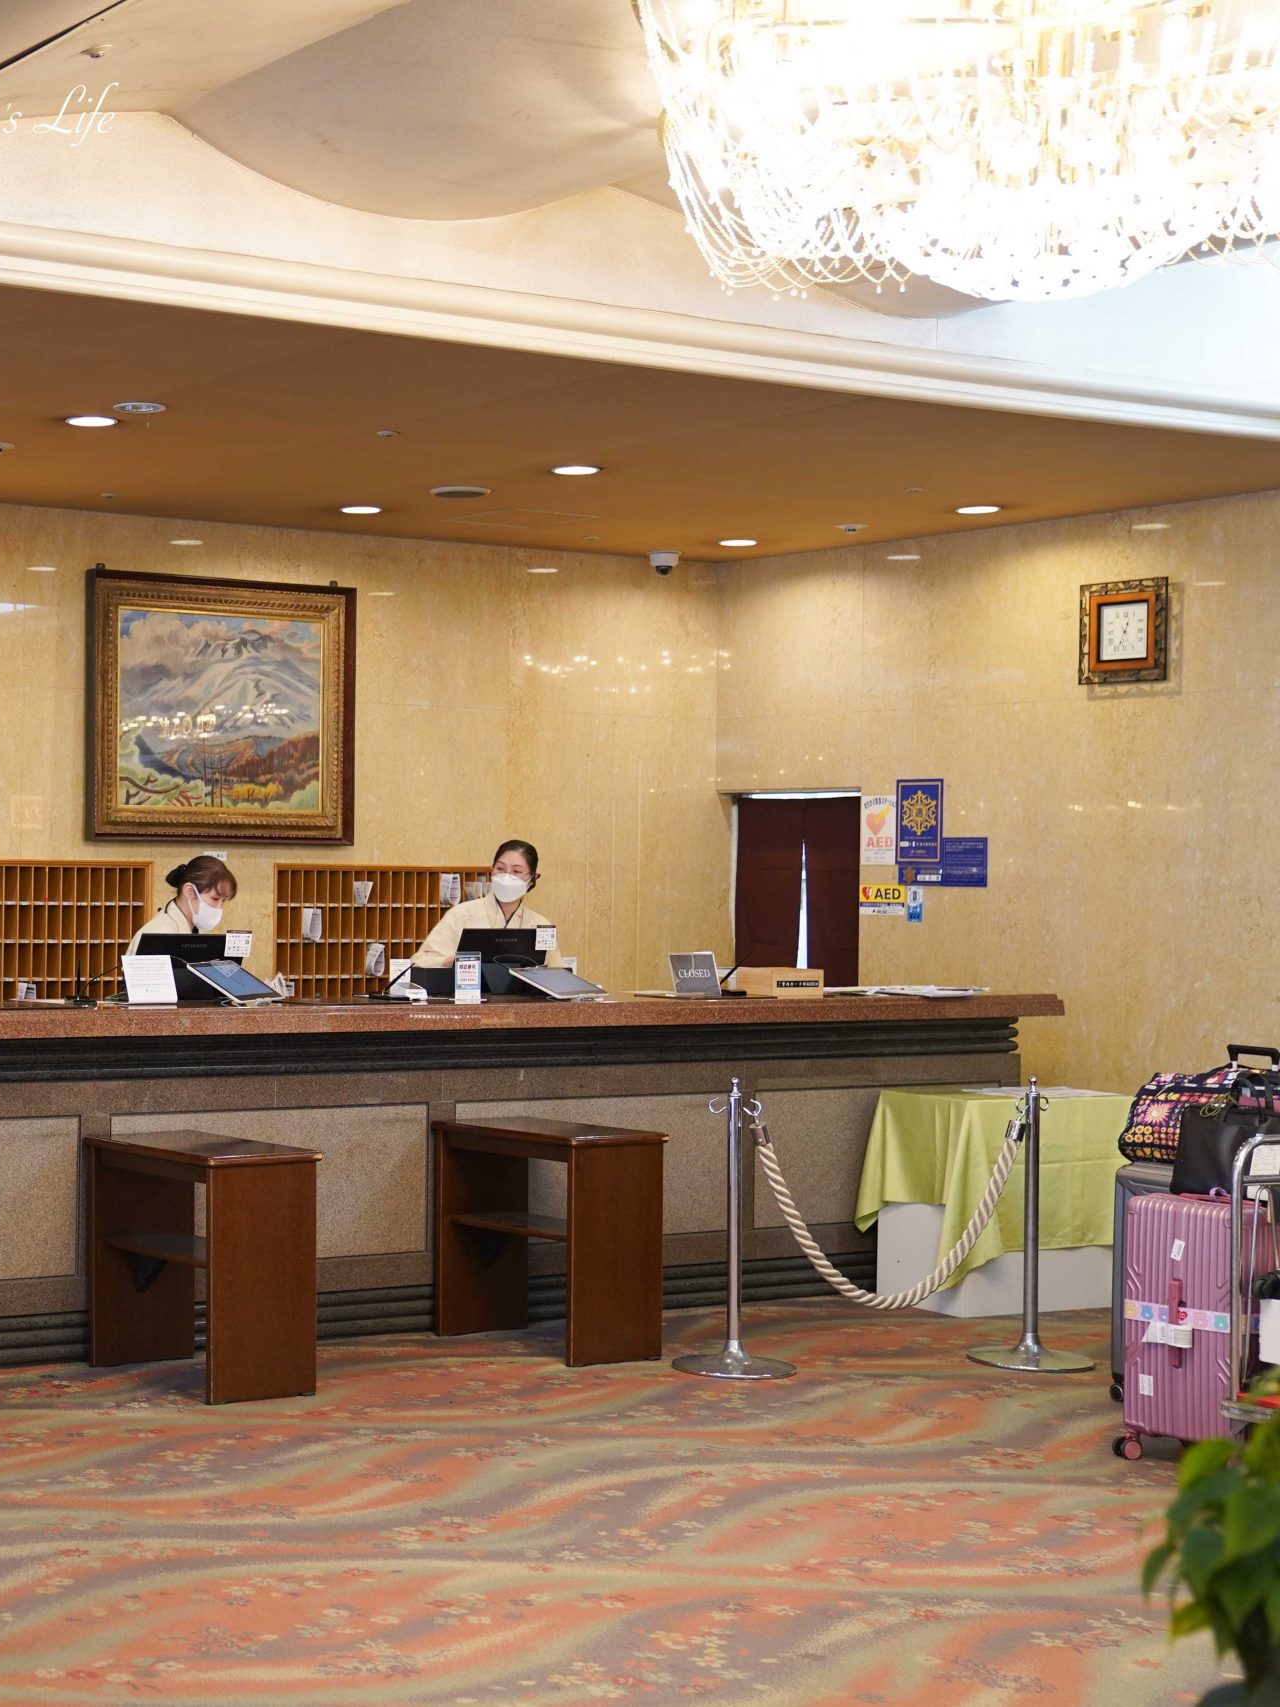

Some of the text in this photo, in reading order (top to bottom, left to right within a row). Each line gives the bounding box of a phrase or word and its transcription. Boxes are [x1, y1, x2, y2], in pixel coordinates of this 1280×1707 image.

[866, 836, 894, 848] AED
[874, 888, 901, 900] AED
[678, 968, 710, 979] CLOSED
